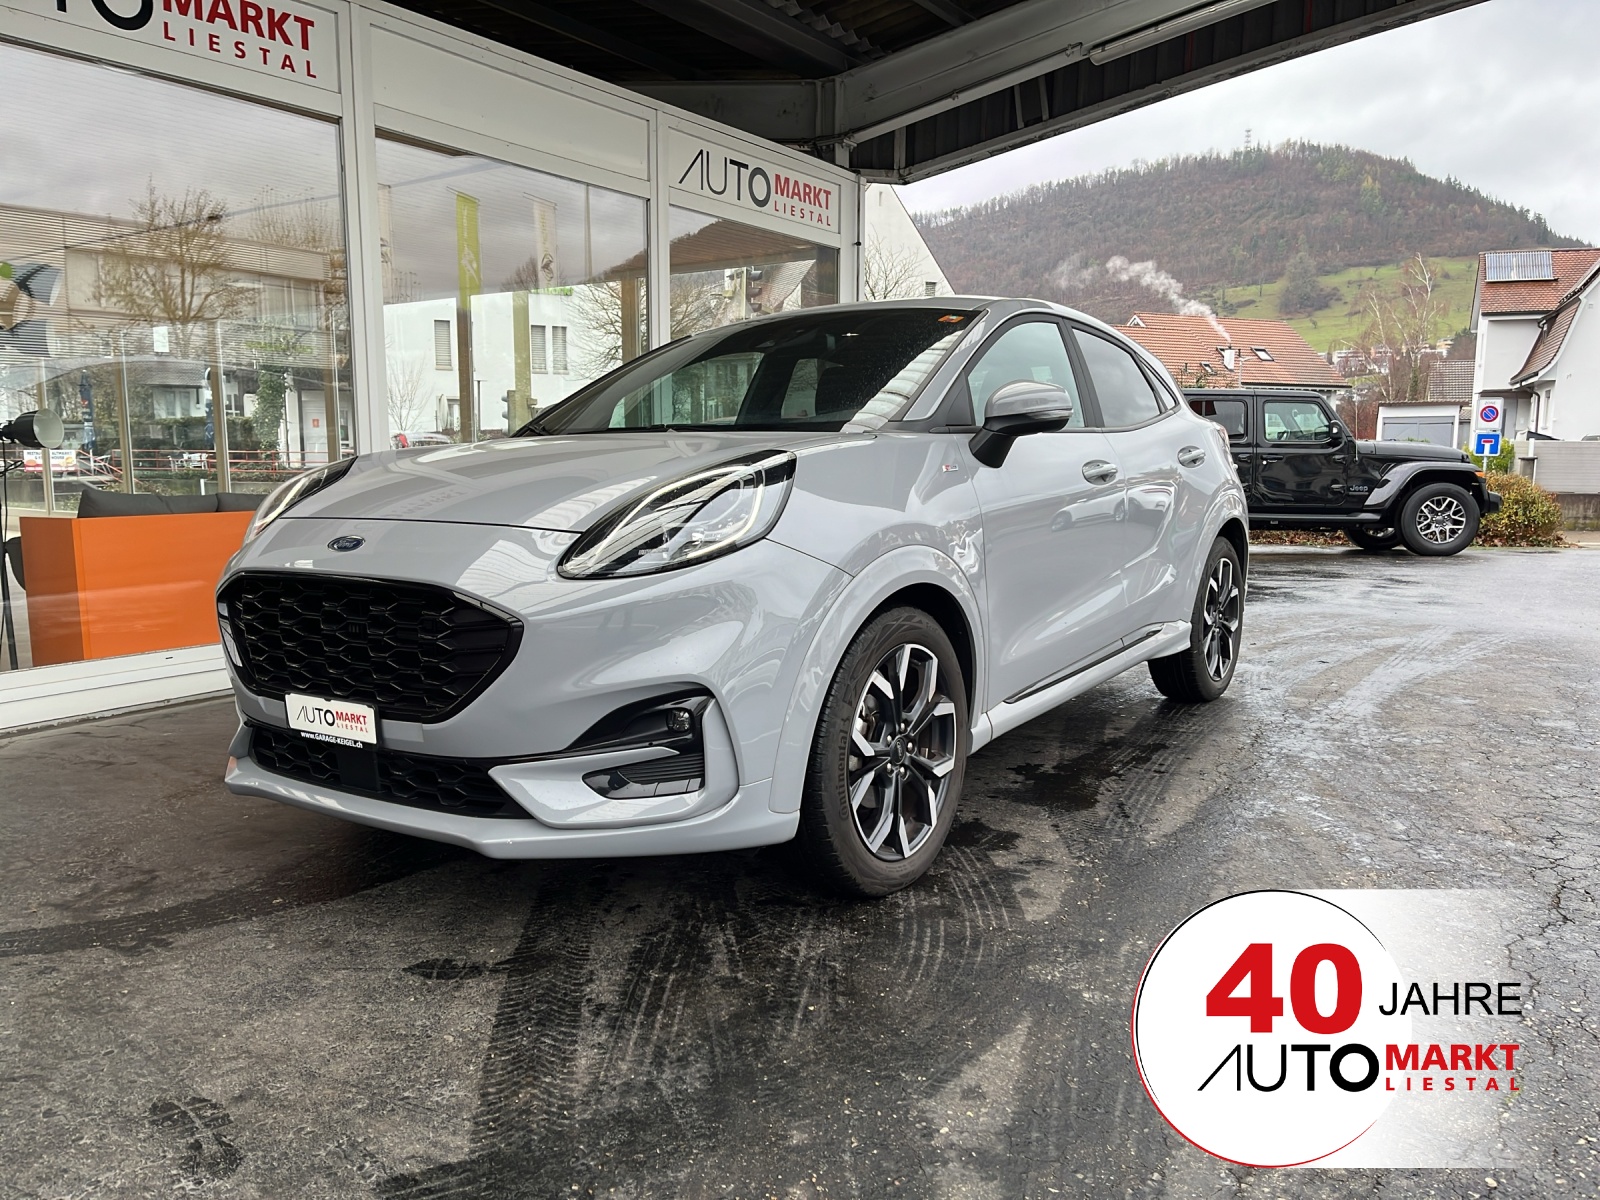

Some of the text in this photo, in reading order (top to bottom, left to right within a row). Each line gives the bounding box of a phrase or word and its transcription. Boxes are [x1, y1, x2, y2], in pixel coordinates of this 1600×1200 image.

[163, 21, 317, 78] LIESTAL
[774, 173, 832, 210] MARKT
[774, 200, 831, 226] LIESTAL
[1349, 484, 1369, 492] Jeep
[335, 710, 367, 725] MARKT
[336, 722, 368, 733] LIESTAL
[836, 729, 849, 820] Continental
